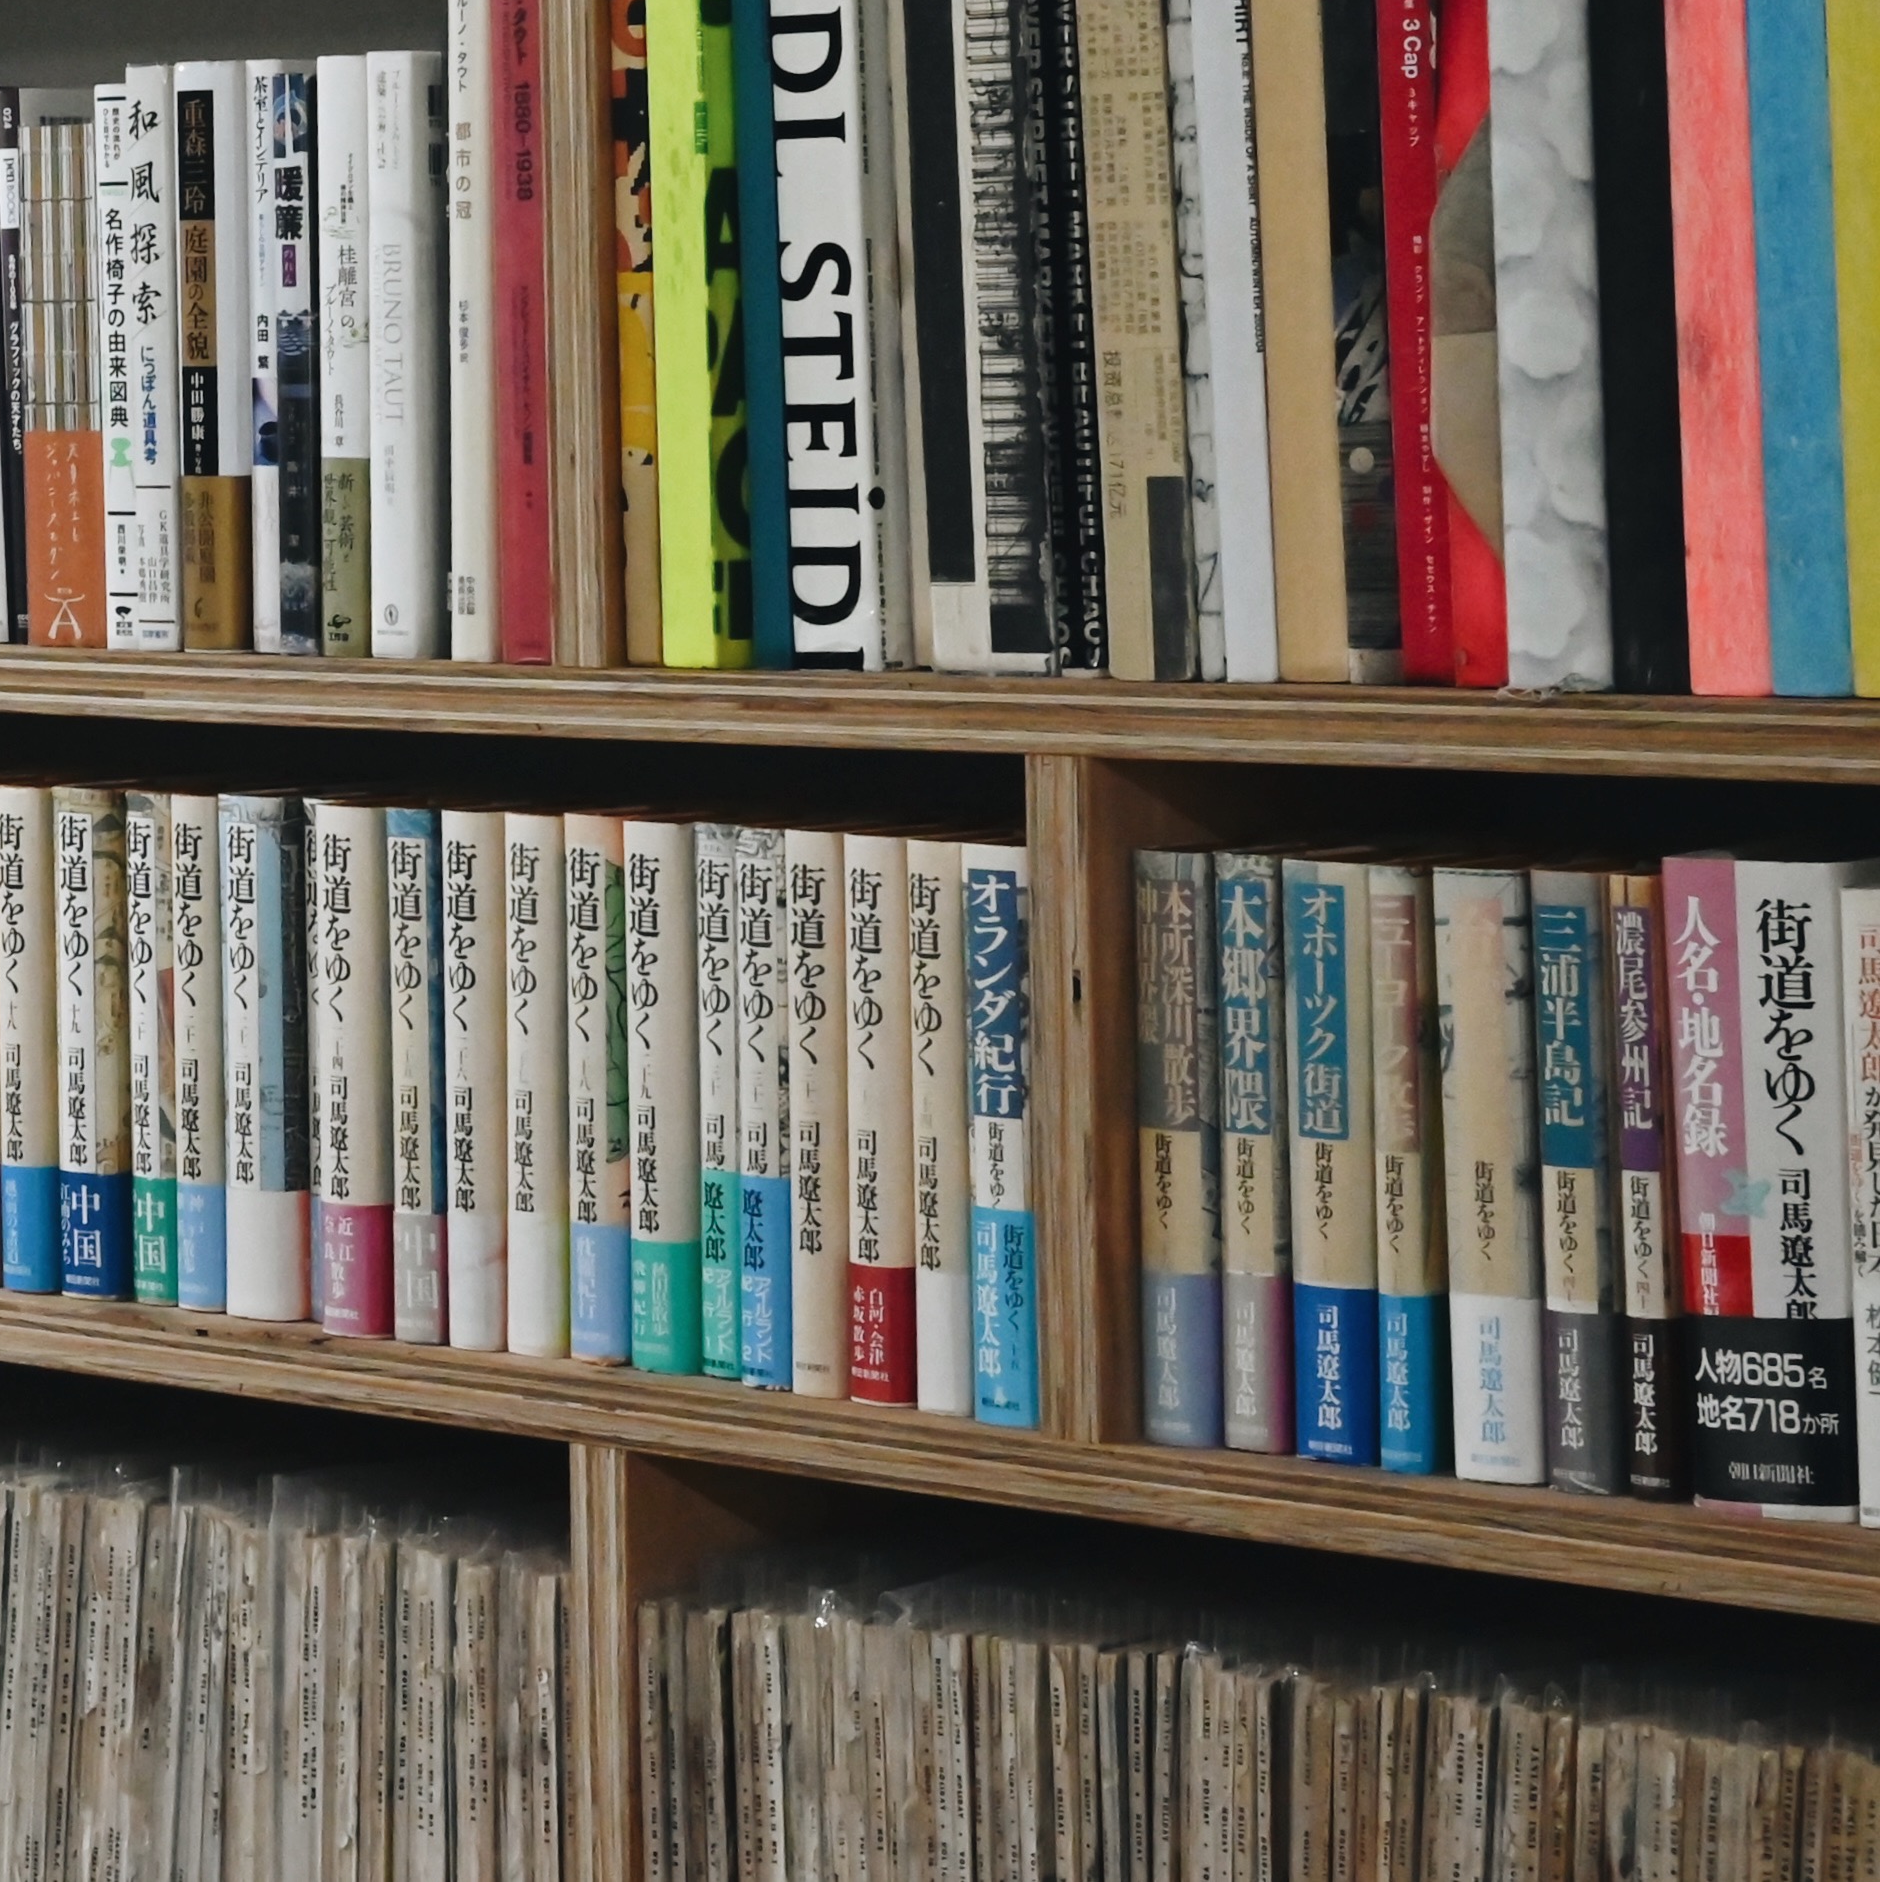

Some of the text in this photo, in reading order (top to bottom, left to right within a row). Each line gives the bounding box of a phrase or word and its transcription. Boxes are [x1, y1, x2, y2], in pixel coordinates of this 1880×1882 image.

[454, 121, 473, 220] 都市の冠
[1401, 36, 1421, 80] Cap
[104, 207, 129, 429] 名作椅子の由来図典
[182, 100, 210, 362] 重森三玲 庭園の全貌
[275, 165, 304, 241] 暖簾
[139, 345, 158, 465] にっぽん道具考
[382, 244, 404, 426] BRUNO TAUT
[60, 814, 89, 1166] 街道をゆく 司馬遼太郎
[447, 842, 477, 1214] 街道をゆく 司馬遼太郎
[789, 865, 827, 1256] 街道をゆく 司馬遼太郎
[909, 873, 943, 1272] 街道をゆく 司馬遼太郎
[969, 873, 1019, 1117] オランダ紀行
[1222, 886, 1269, 1135] 本郷界隈
[1539, 911, 1586, 1130] 三浦半島記
[1676, 896, 1730, 1158] 人名・地名録
[1755, 898, 1816, 1158] 街道をゆく
[71, 1185, 102, 1268] 中国
[1301, 888, 1343, 1431] オホーツク街道 街道をゆく 司馬遼太郎
[1695, 1347, 1828, 1390] 人物685名
